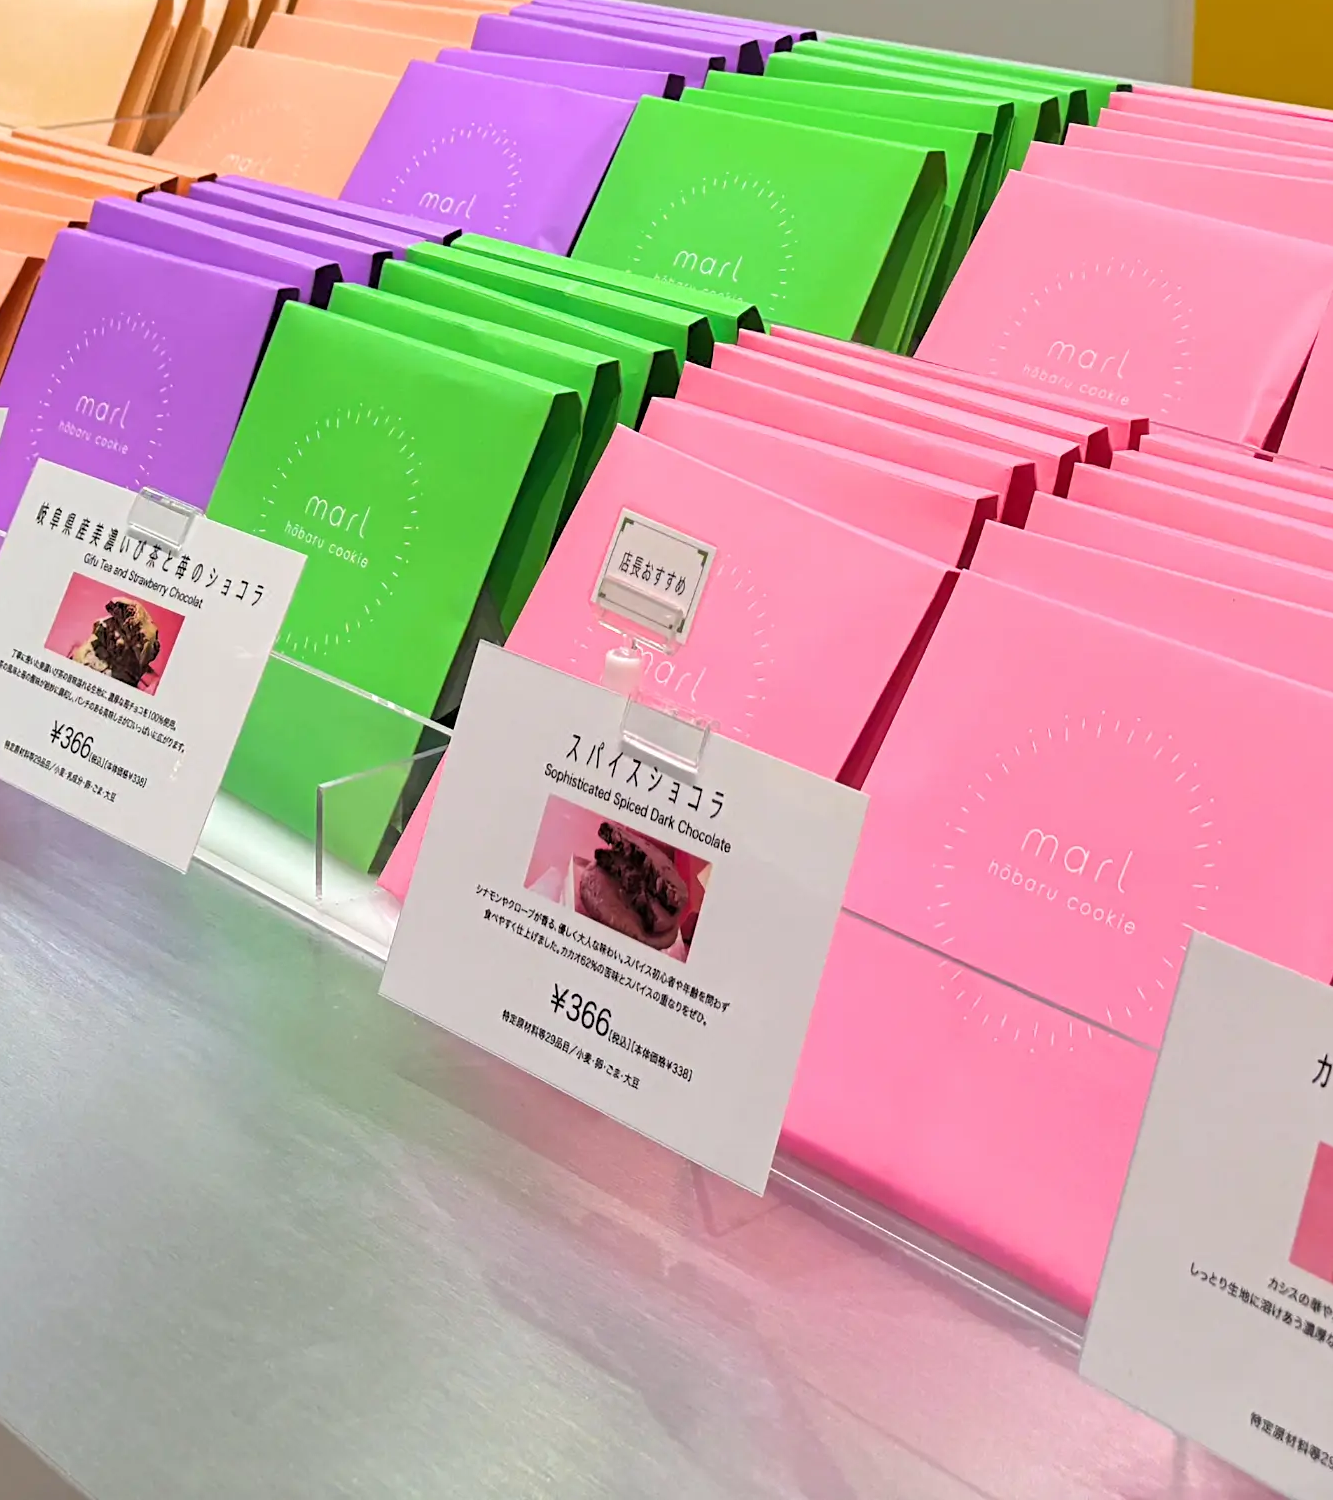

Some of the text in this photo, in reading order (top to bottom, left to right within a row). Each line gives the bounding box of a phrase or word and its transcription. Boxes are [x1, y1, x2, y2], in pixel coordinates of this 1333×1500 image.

[419, 191, 477, 220] marl
[673, 250, 743, 283] marl
[1047, 340, 1131, 380] marl
[1023, 363, 1131, 407] hōbaru cookie
[75, 395, 131, 429] marl
[95, 435, 129, 455] cookie
[304, 495, 371, 539] marl
[36, 503, 264, 606] 岐阜県産美濃いび茶と苺のショコラ
[284, 520, 369, 568] hōbaru cookie
[83, 552, 204, 609] Gifu Tea and Strawberry Chocolat
[619, 551, 686, 596] 店長おすすめ
[50, 720, 94, 759] ¥366
[566, 734, 724, 819] スパイスショコラ
[544, 763, 731, 853] Sophisticated Spiced Dark Chocolate
[1021, 828, 1133, 894] marl
[987, 860, 1136, 935] hōbaru cookie
[484, 909, 707, 1026] 食べやすく仕上げました。カカオ62%の苦味とスパイスの重なりをぜひ。
[550, 983, 693, 1082] ¥366 [税込][本体価格¥338]
